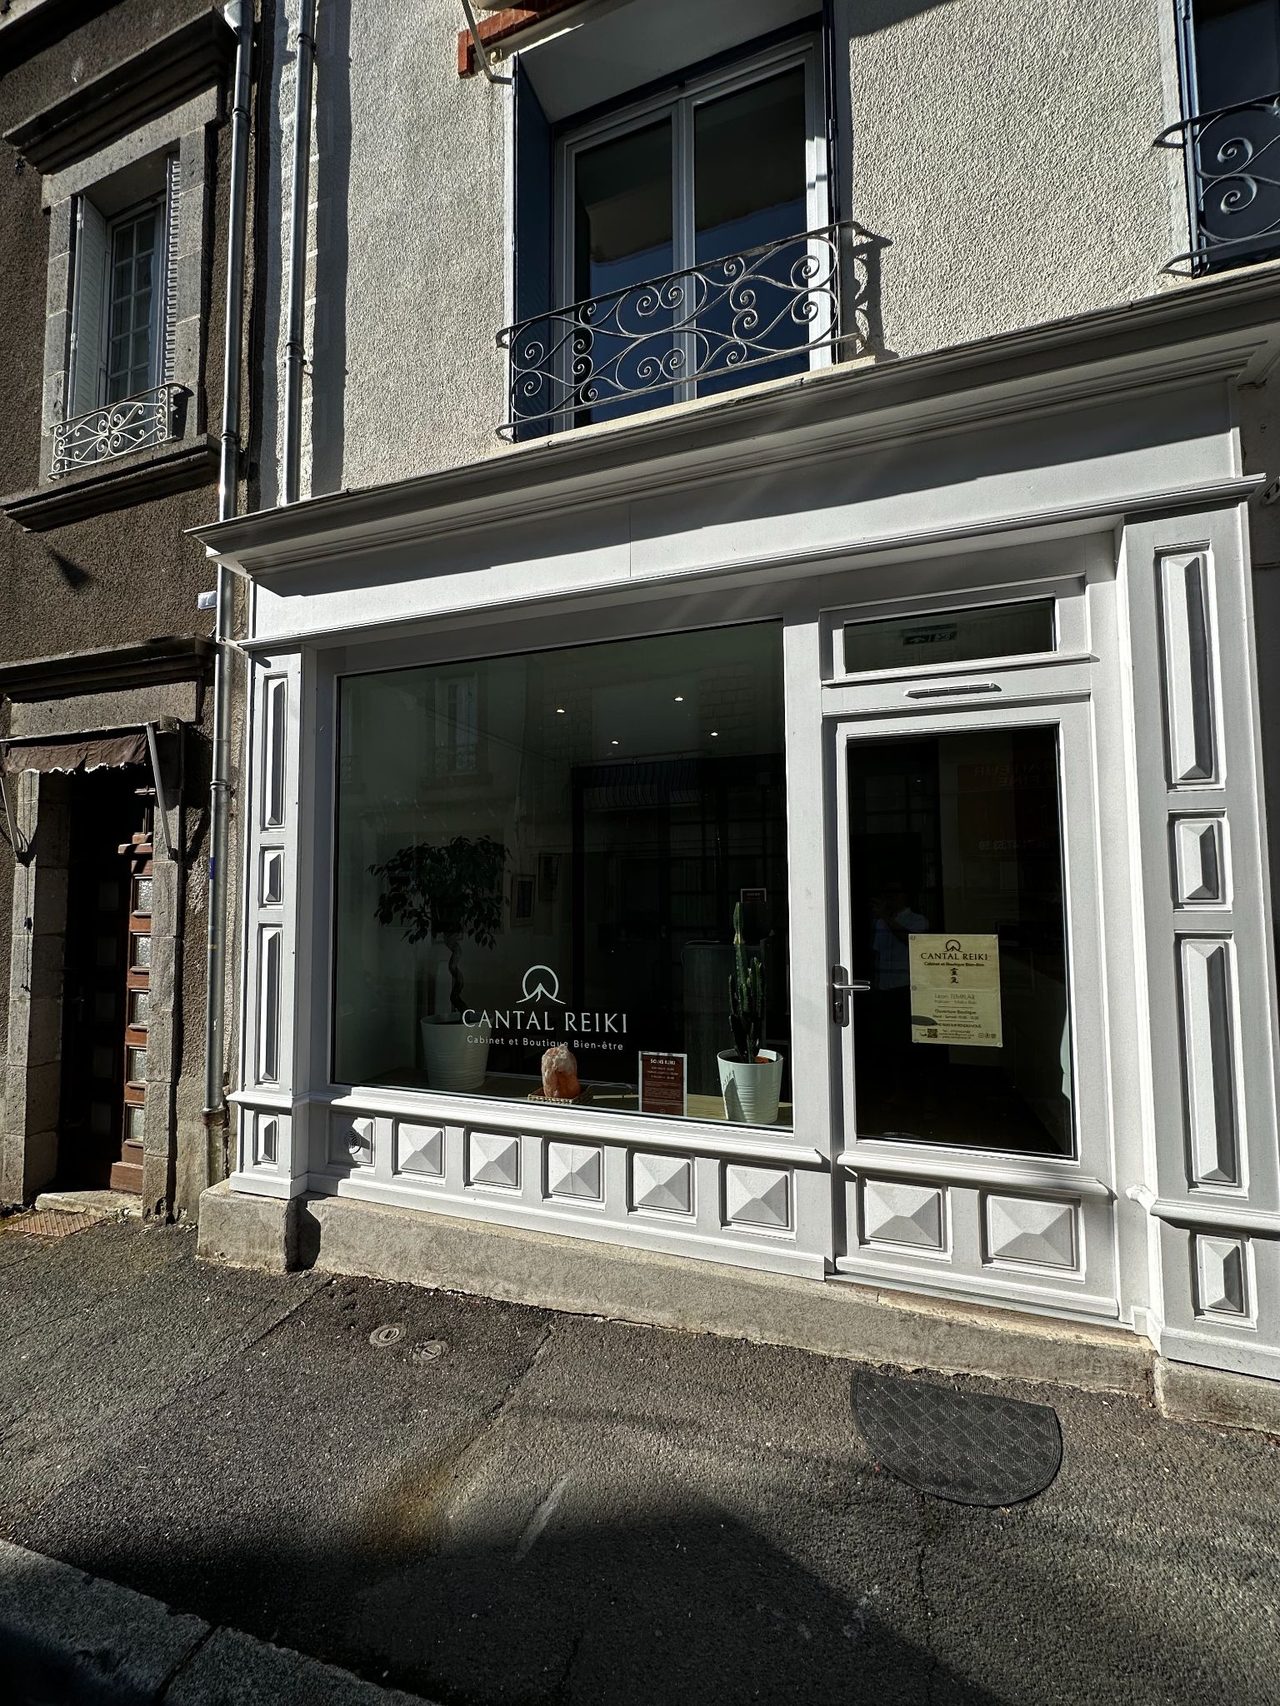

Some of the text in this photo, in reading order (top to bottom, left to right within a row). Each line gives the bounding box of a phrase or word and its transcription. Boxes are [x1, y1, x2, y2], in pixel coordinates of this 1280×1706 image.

[963, 953, 988, 961] REIKI
[462, 1009, 627, 1034] CANTAL REIKI
[466, 1035, 624, 1051] Cabinet et Boutique Bien-être
